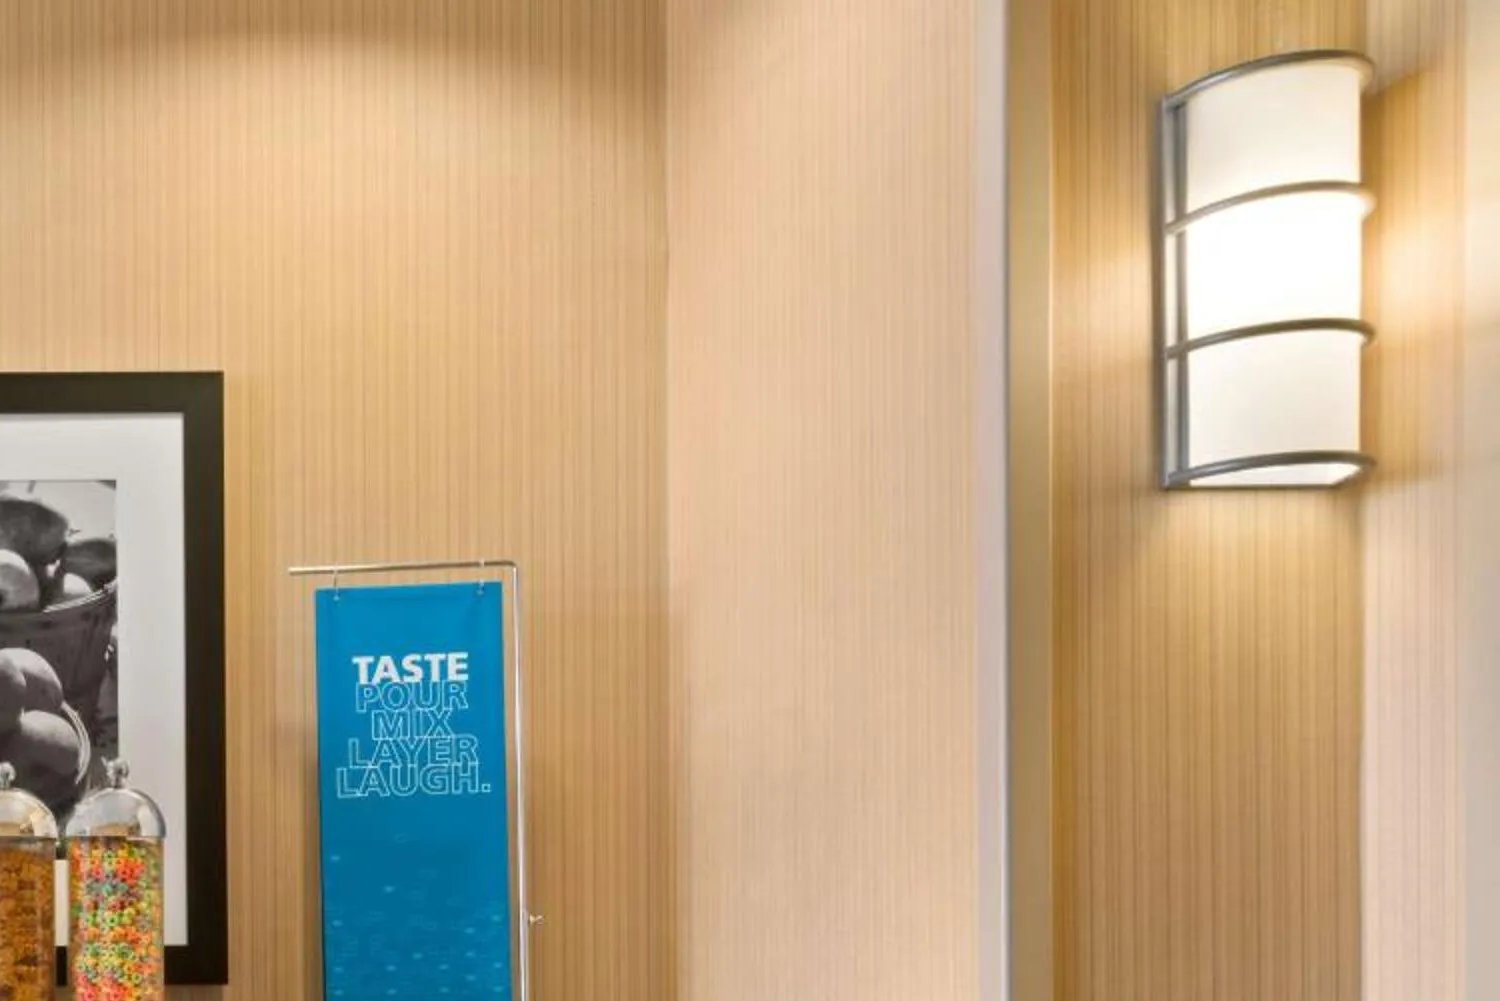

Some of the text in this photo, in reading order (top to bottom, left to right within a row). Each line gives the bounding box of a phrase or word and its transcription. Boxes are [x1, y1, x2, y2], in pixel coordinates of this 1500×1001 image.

[352, 652, 469, 684] TASTE
[355, 680, 469, 713] POUR
[371, 707, 455, 740] MIX
[348, 734, 480, 768] LAYER
[336, 762, 492, 798] LAUGH.
